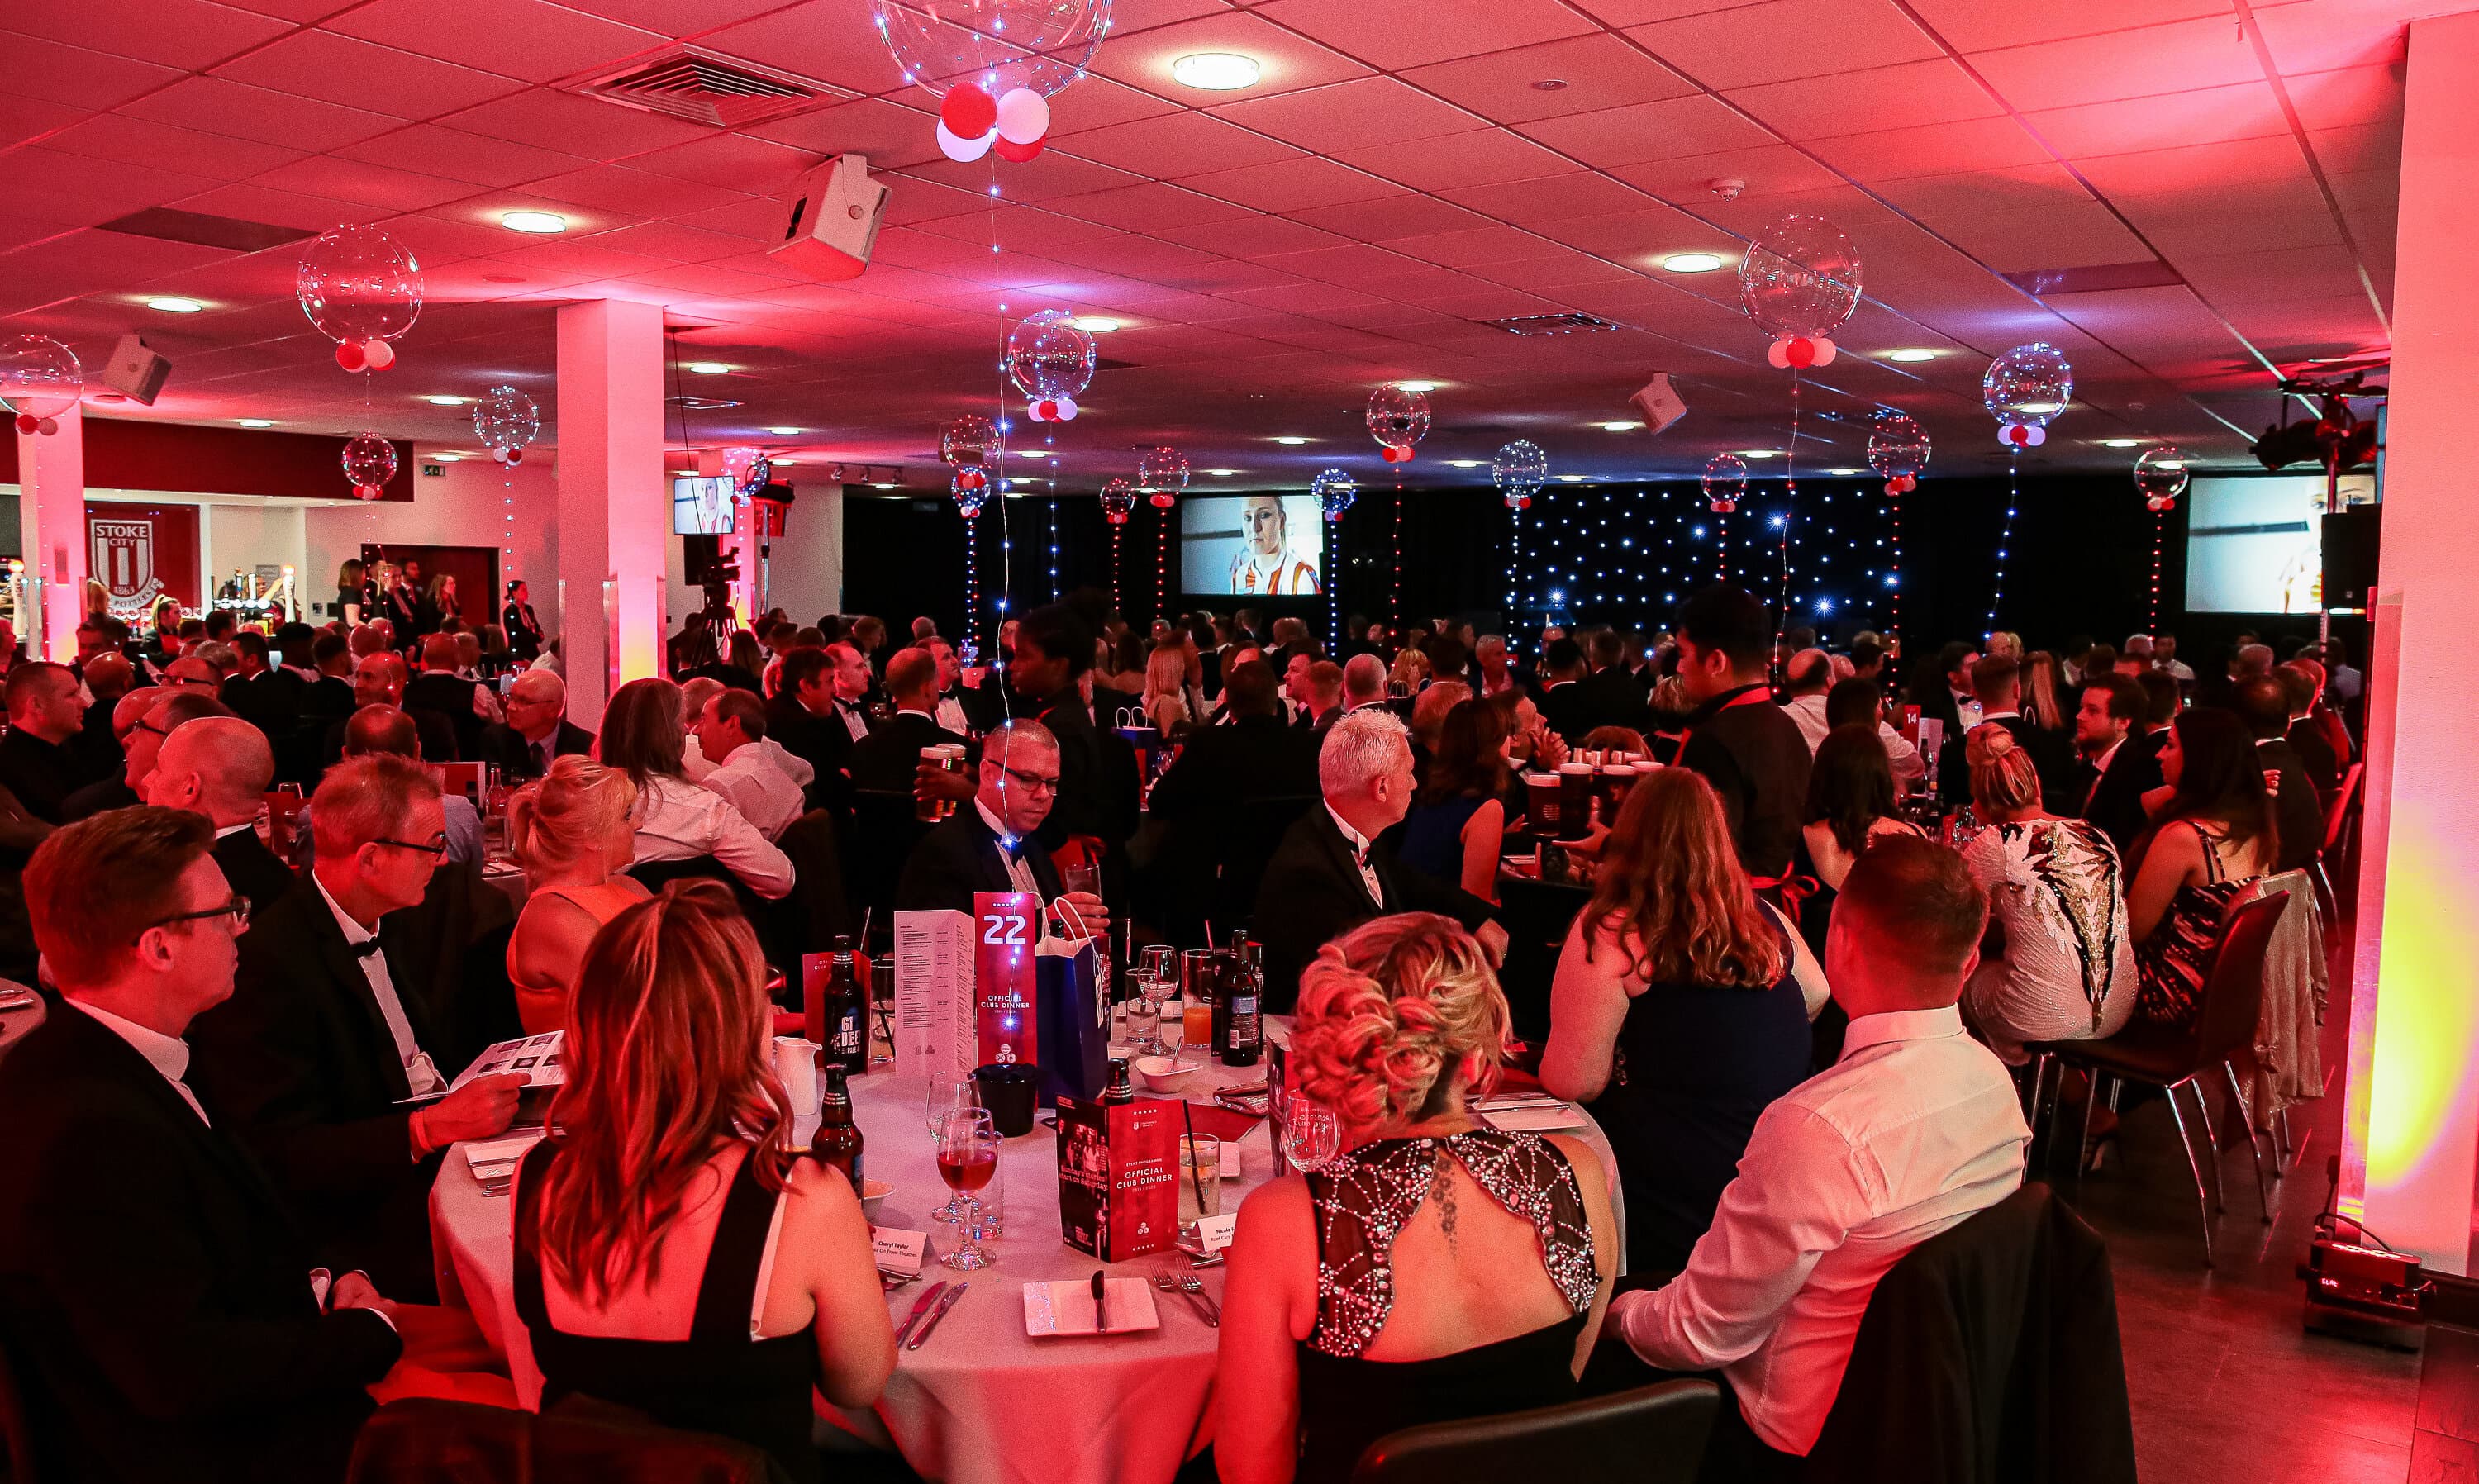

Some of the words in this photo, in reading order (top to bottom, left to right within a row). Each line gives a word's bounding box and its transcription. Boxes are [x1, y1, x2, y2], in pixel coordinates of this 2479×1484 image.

[96, 525, 148, 538] STOKE
[109, 538, 136, 546] CITY
[1907, 713, 1917, 724] 14
[983, 914, 1025, 944] 22
[841, 1016, 854, 1032] 61
[841, 1030, 860, 1047] DEE
[1125, 1167, 1163, 1178] OFFICIAL
[1116, 1179, 1137, 1189] CLUB
[1140, 1173, 1173, 1185] DINNER
